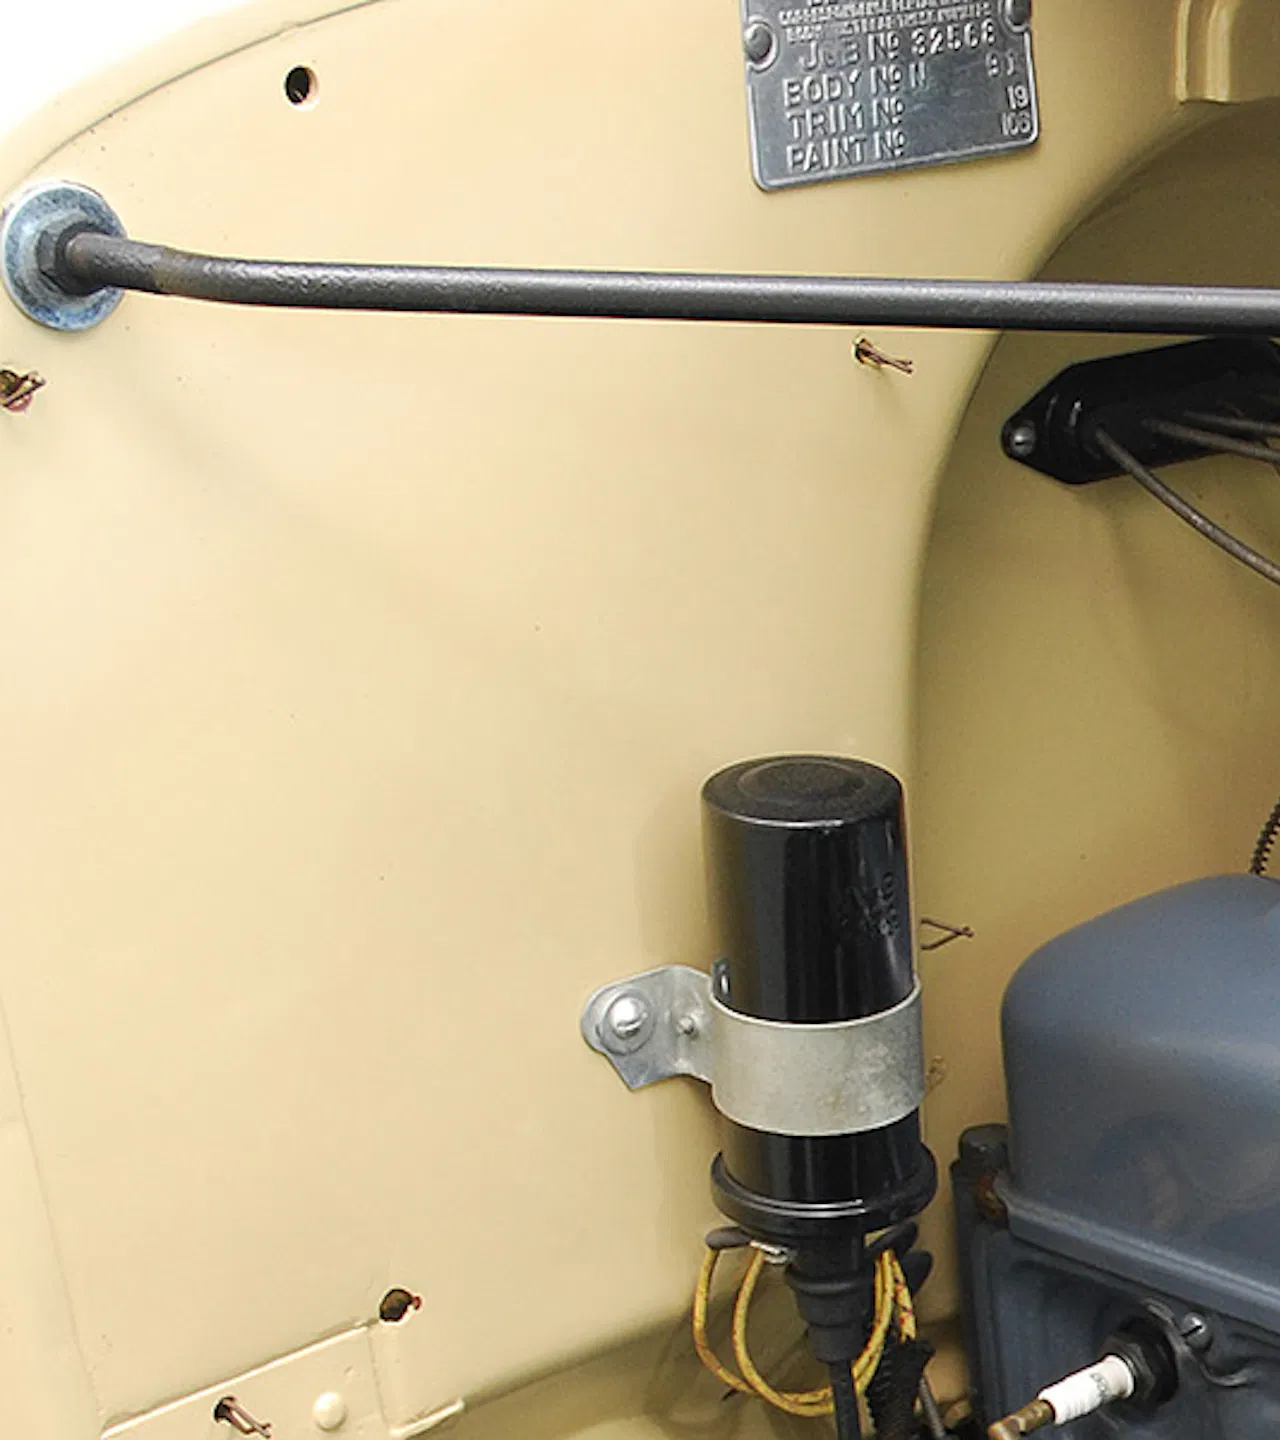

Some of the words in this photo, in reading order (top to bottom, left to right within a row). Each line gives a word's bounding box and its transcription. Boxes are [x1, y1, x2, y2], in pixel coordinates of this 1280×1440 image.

[783, 68, 860, 108] BODY
[785, 100, 864, 141] TRIM
[785, 132, 868, 174] PAINT
